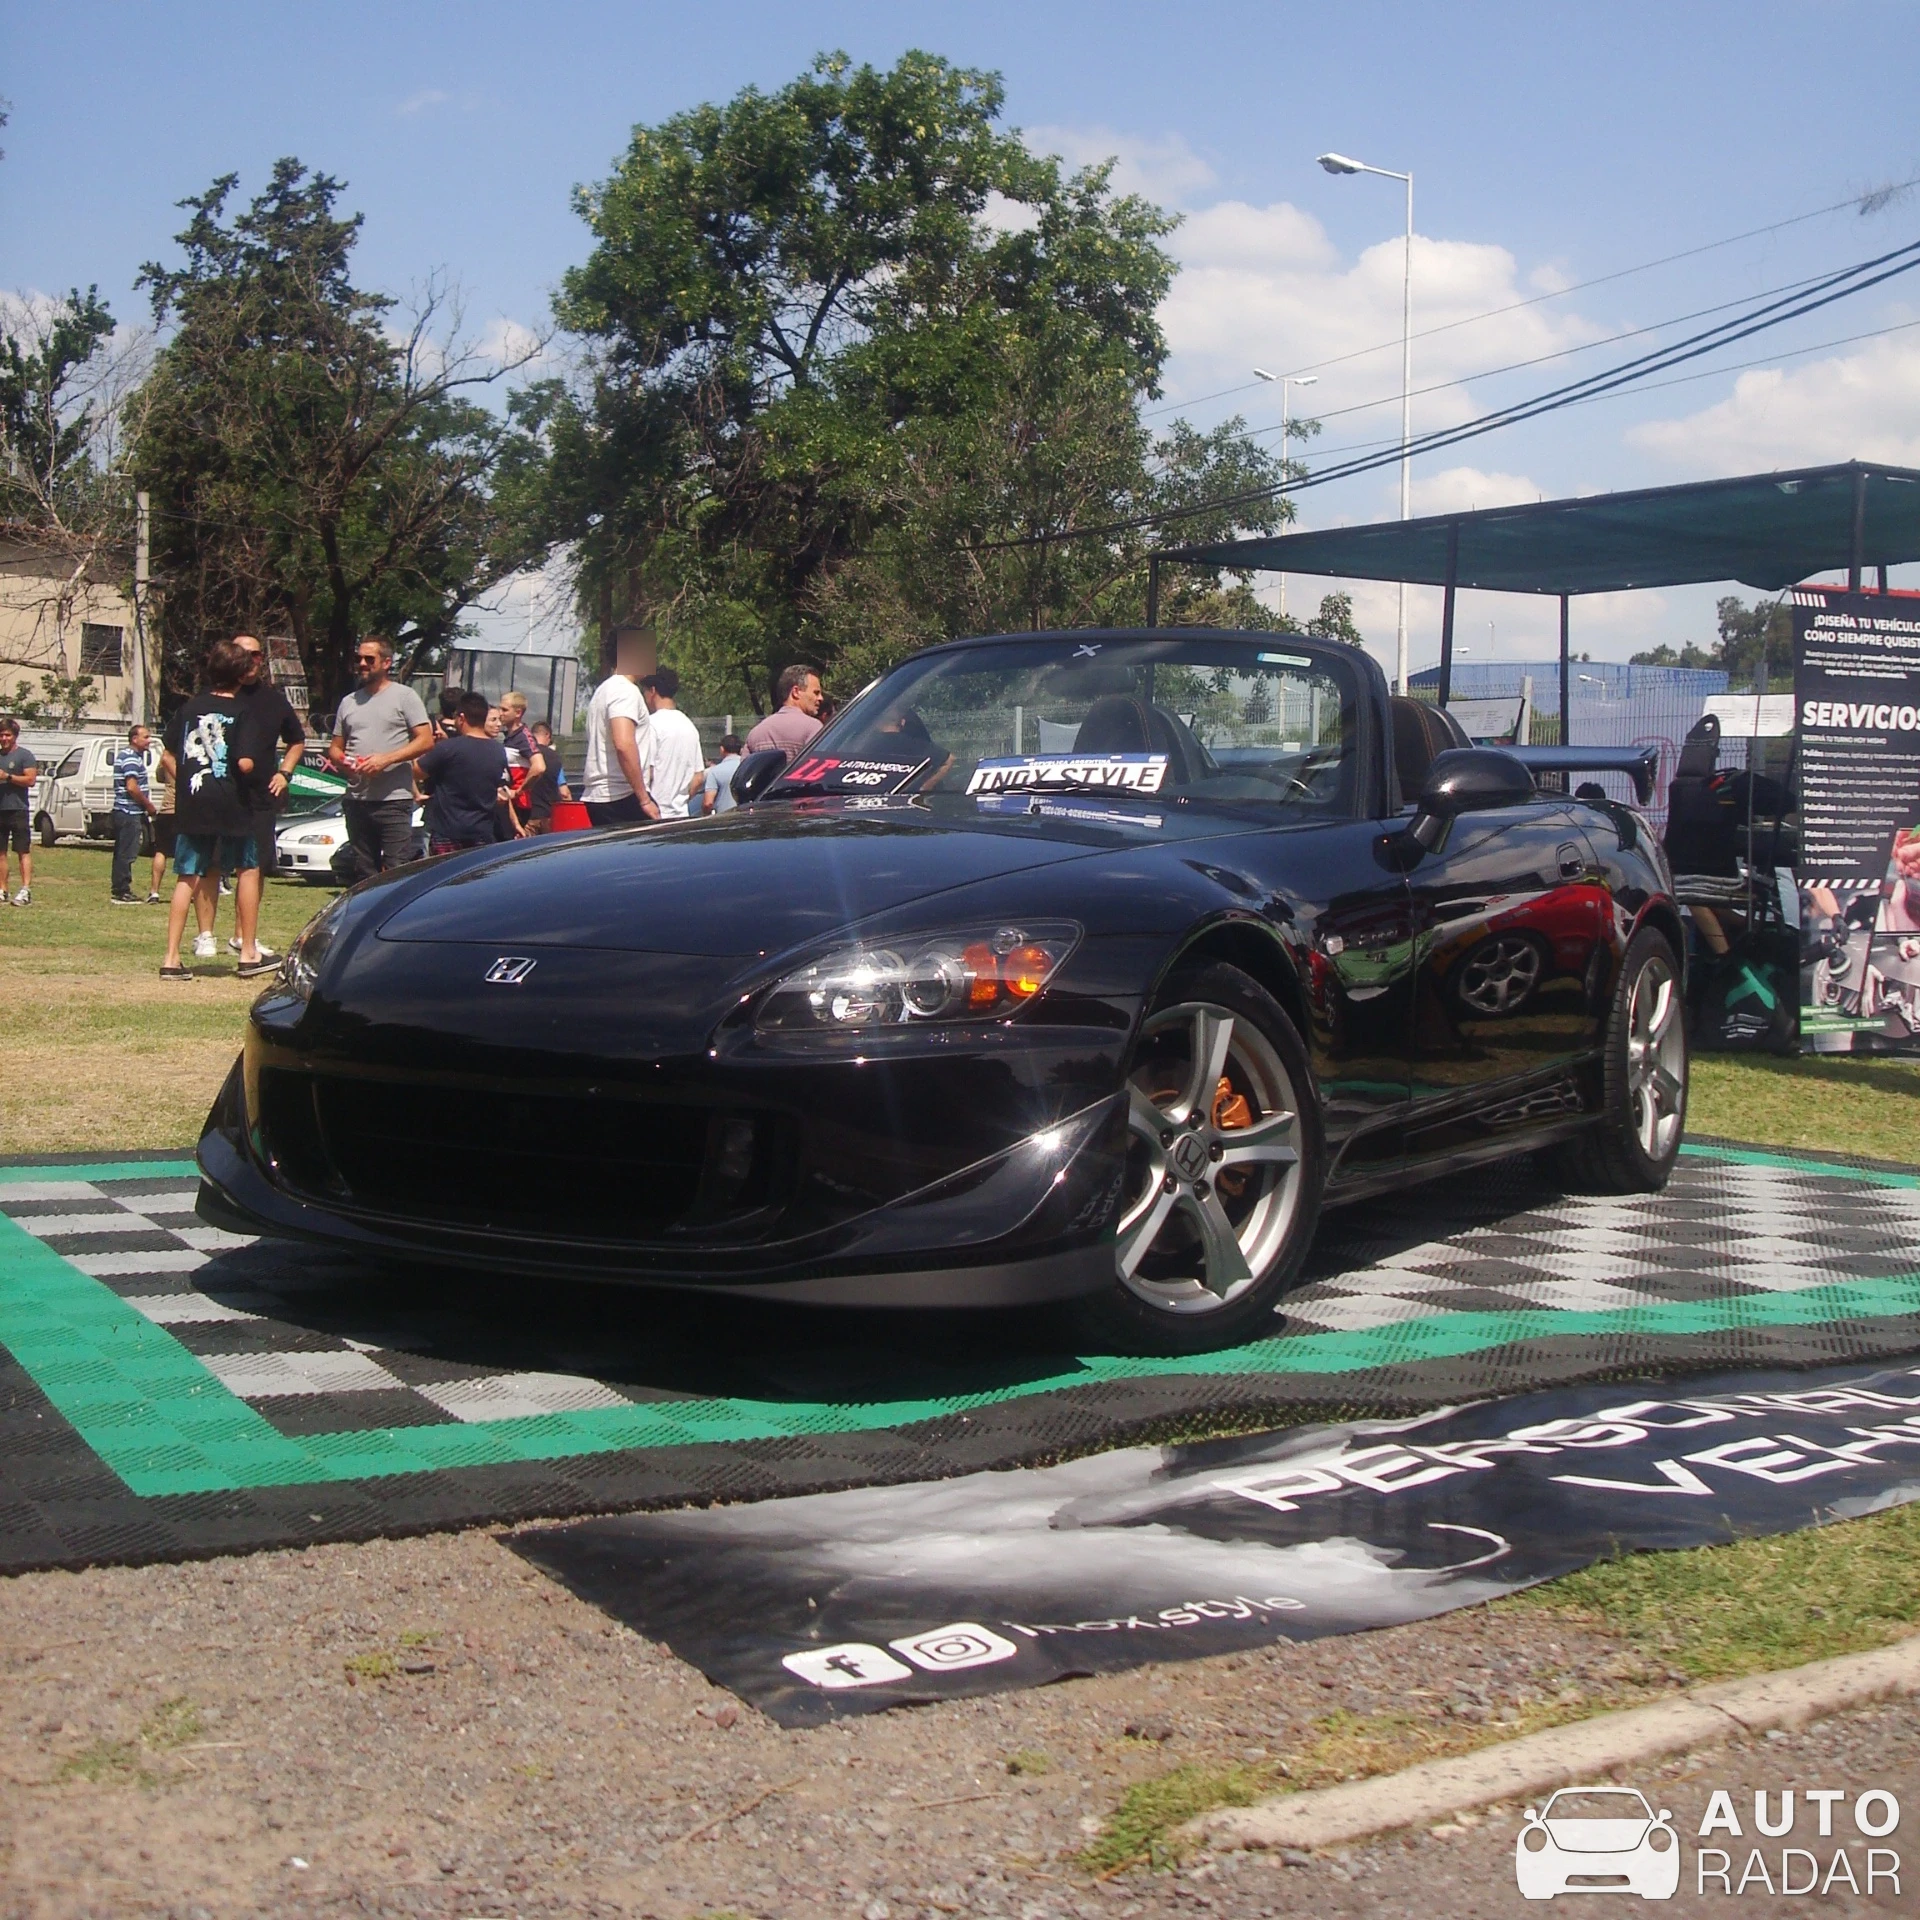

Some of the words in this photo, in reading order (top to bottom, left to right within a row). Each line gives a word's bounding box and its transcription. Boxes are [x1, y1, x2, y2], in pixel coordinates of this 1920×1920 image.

[1857, 617, 1872, 629] TU
[1804, 629, 1836, 642] COMO
[1837, 631, 1883, 646] SIEMPRE
[304, 753, 339, 773] INOX
[841, 770, 887, 785] CARS
[1060, 766, 1160, 789] STYLE
